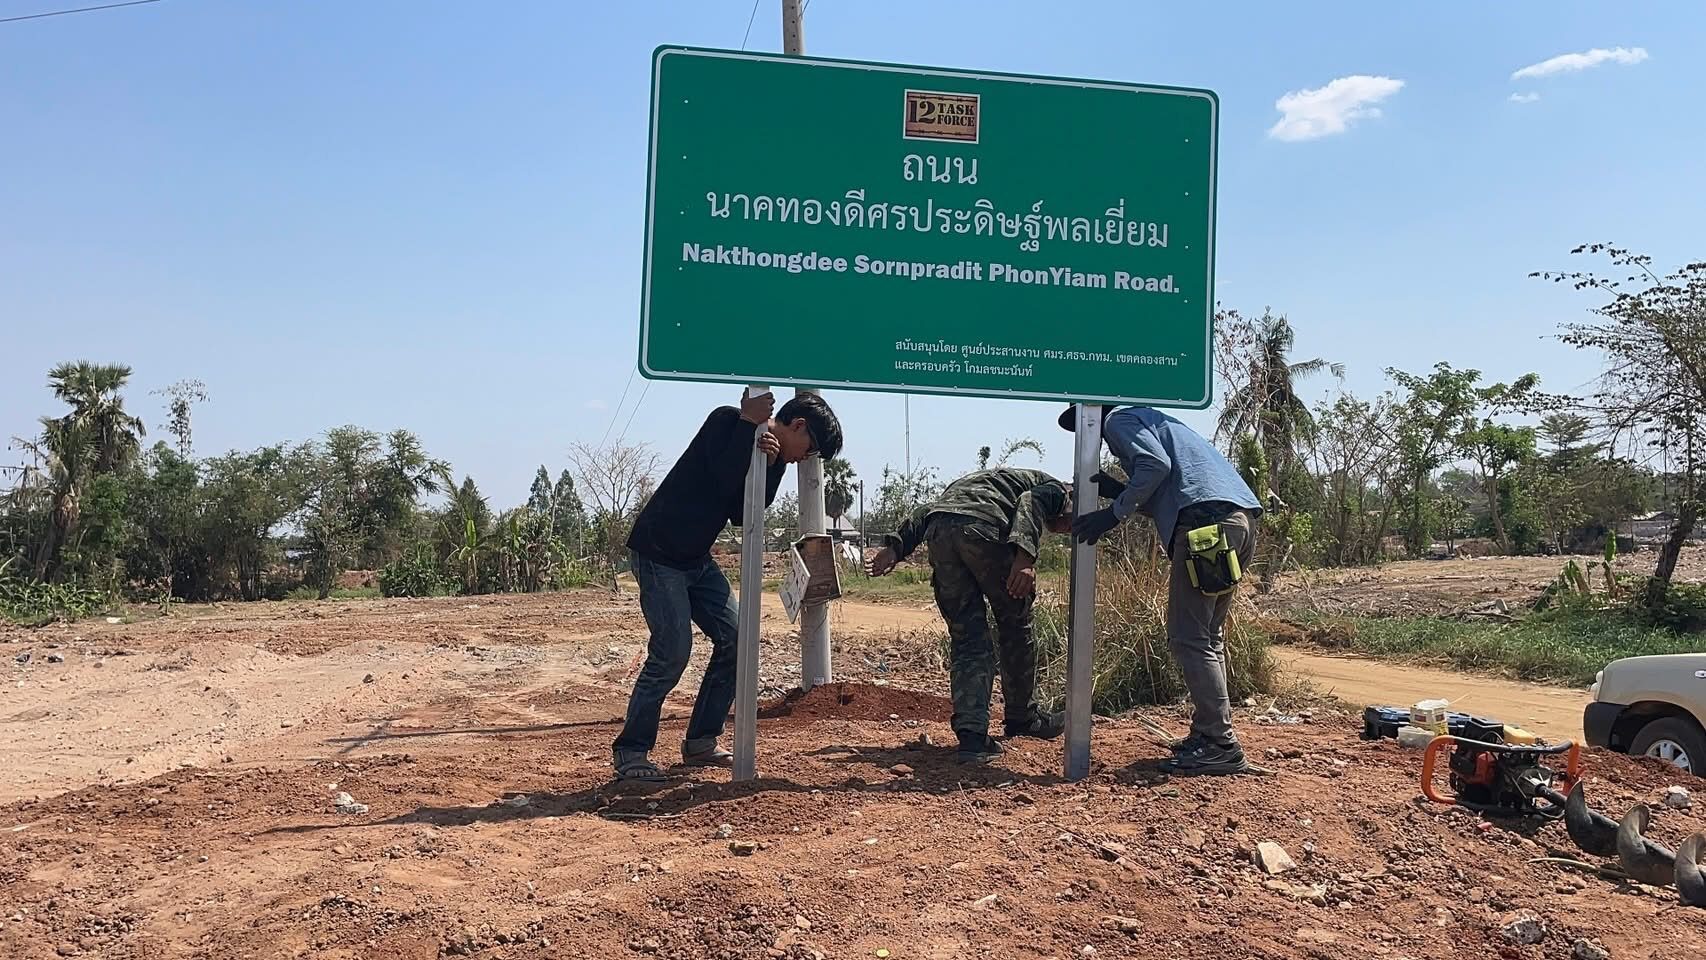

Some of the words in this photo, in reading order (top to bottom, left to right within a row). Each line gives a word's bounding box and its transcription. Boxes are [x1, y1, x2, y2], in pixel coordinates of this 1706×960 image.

[908, 100, 936, 124] 12
[937, 103, 975, 115] TASK
[937, 114, 975, 127] FORCE
[903, 153, 978, 185] ถนน
[706, 188, 1168, 252] นาคทองดีศรประดิษฐ์พลเยี่ยม
[683, 243, 848, 273] Nakthongdee
[854, 254, 983, 280] Sornpradit
[989, 263, 1107, 288] PhonYiam
[1114, 271, 1180, 293] Road.
[895, 338, 958, 356] สนับสนุนโดย
[961, 341, 1040, 358] ศูนย์ประสานงาน
[1116, 353, 1178, 366] เขตคลองสาน
[894, 359, 961, 373] และครอบครัว
[964, 361, 1033, 377] โกมลชนะนันท์
